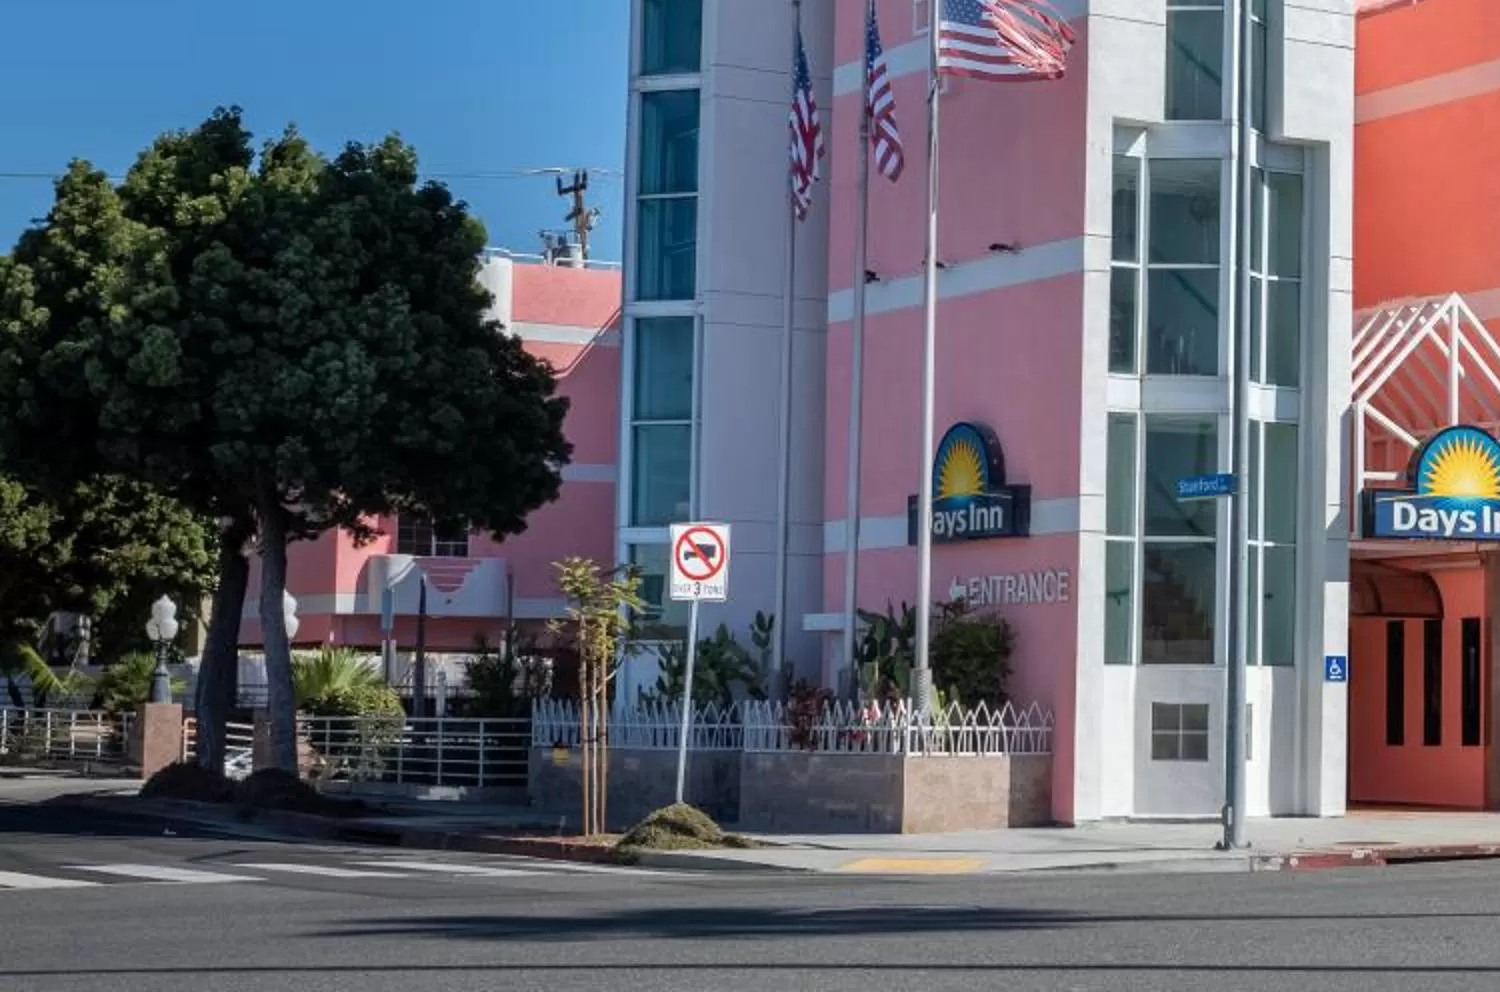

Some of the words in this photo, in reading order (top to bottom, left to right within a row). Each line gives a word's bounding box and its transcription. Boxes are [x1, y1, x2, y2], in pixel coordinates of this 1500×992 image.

[928, 509, 967, 537] ays
[969, 504, 1003, 531] Inn
[1393, 501, 1476, 536] Days
[969, 571, 1069, 605] ENTRANCE
